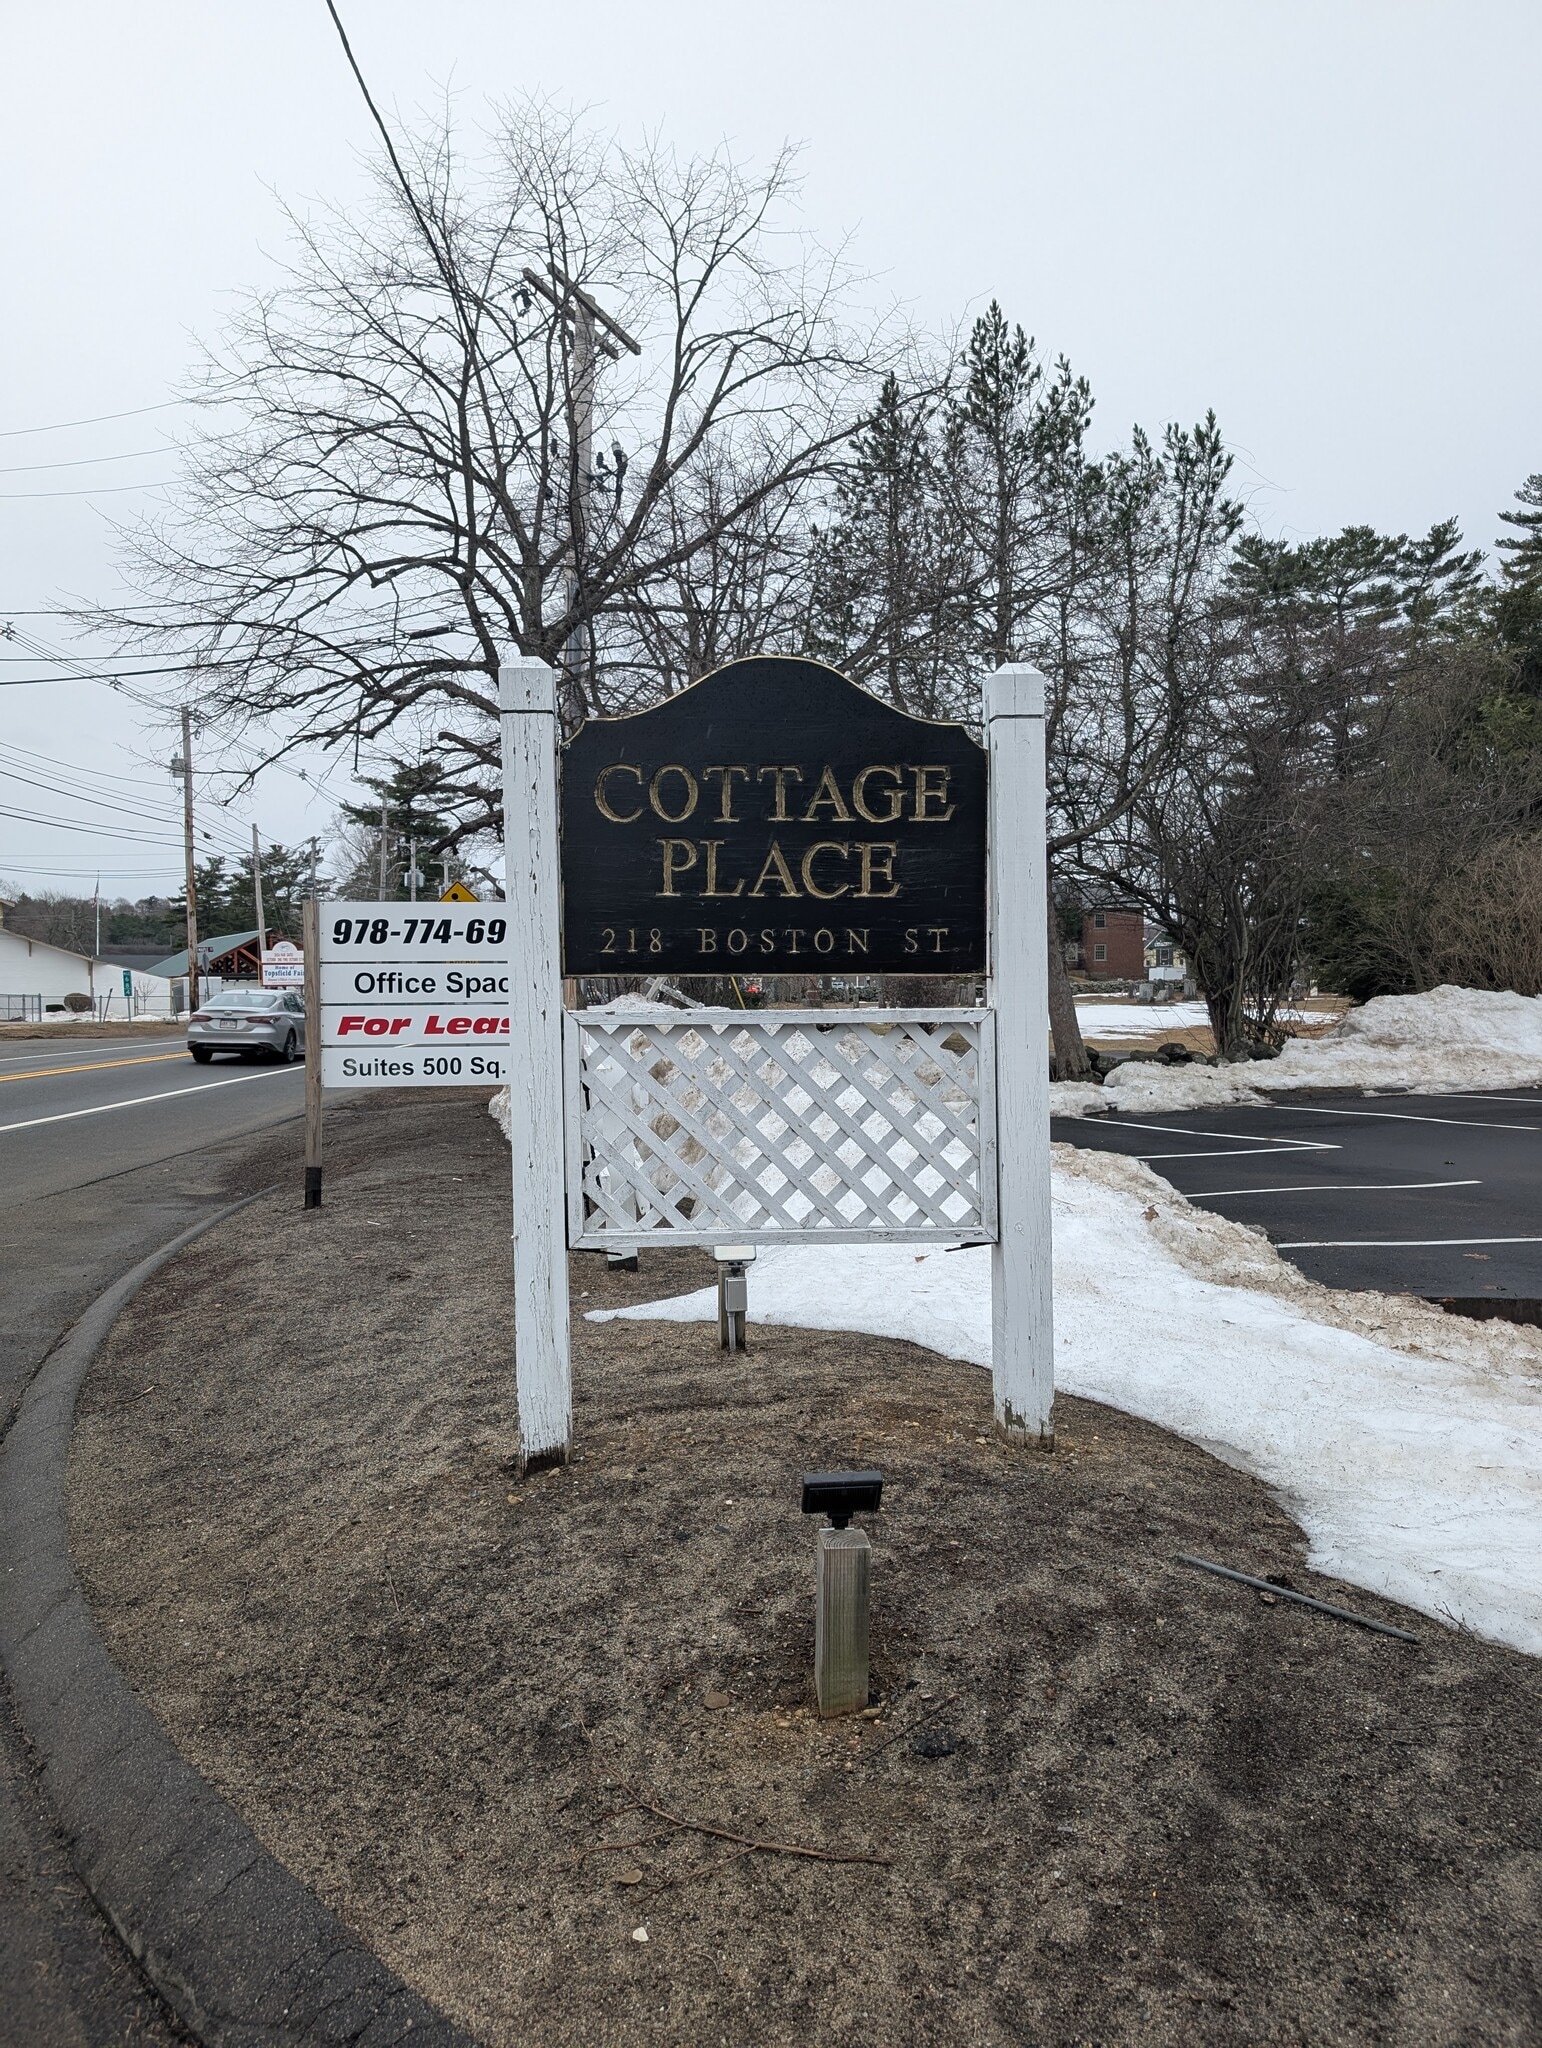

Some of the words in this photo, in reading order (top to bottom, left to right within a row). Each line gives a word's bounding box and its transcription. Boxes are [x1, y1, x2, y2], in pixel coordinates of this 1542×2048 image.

[594, 763, 956, 823] COTTAGE
[655, 838, 901, 899] PLACE
[332, 918, 507, 945] 978-774-69
[600, 928, 663, 953] 218
[698, 928, 871, 954] BOSTON
[354, 972, 437, 994] Office
[446, 971, 509, 998] Spac
[336, 1016, 412, 1036] For
[342, 1058, 415, 1077] Suites
[423, 1057, 462, 1075] 500
[470, 1056, 506, 1079] Sq.
